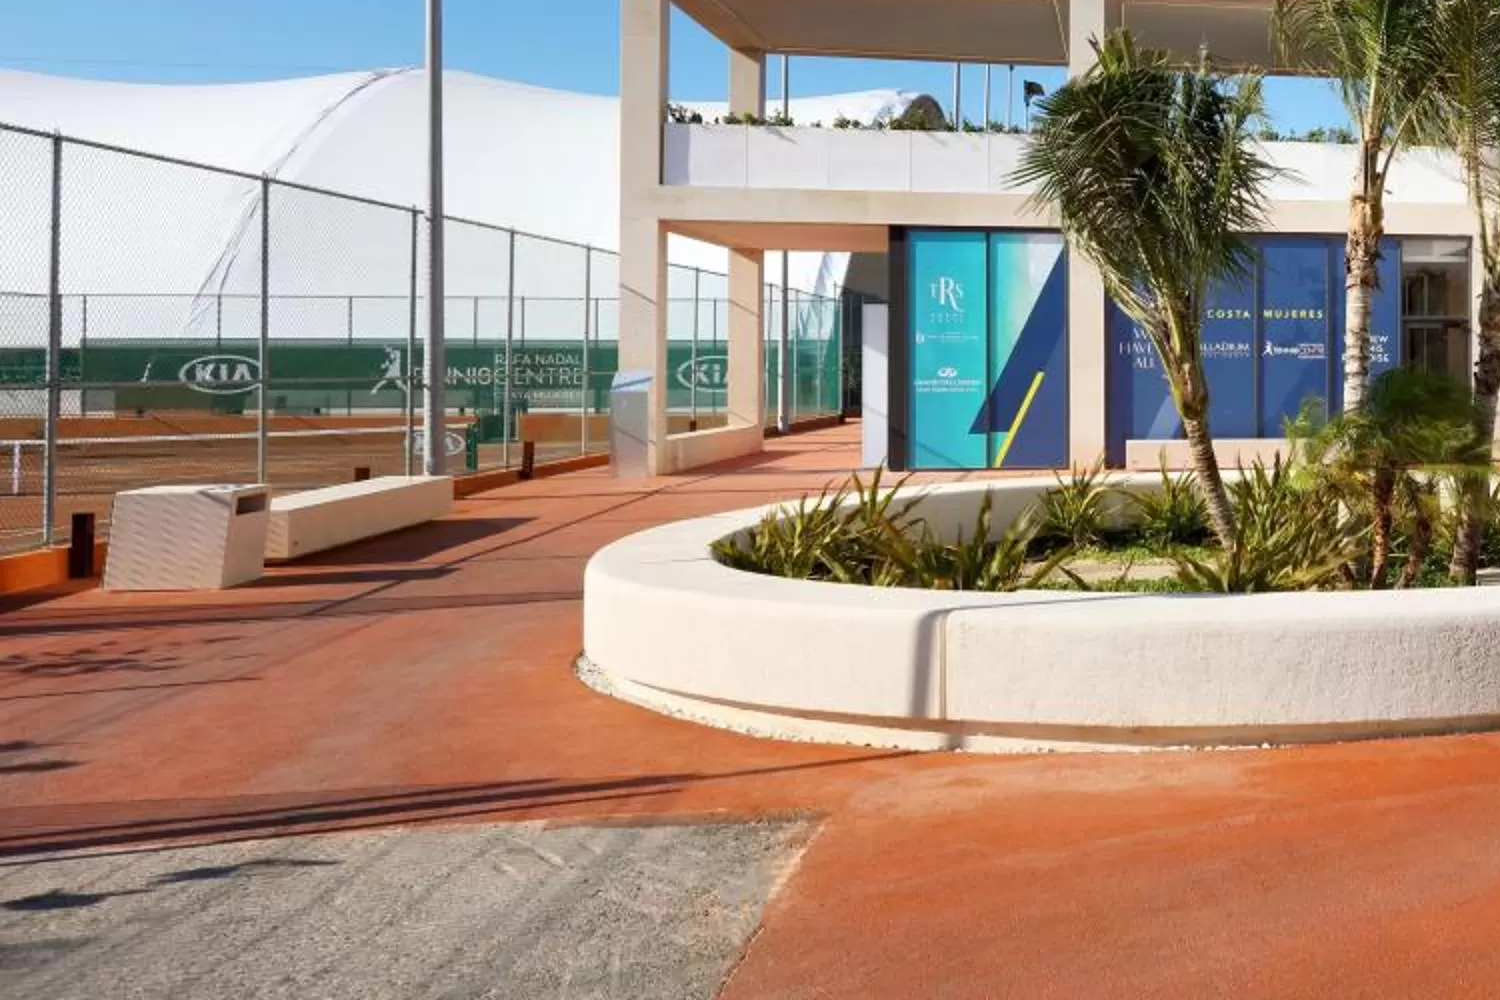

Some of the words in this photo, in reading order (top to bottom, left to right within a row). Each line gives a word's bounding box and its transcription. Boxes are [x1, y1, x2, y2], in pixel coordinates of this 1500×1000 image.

[1207, 309, 1251, 319] COSTA
[1263, 309, 1324, 319] MUJERES
[495, 353, 532, 365] RFA
[195, 363, 252, 382] KIA
[695, 363, 728, 384] KI
